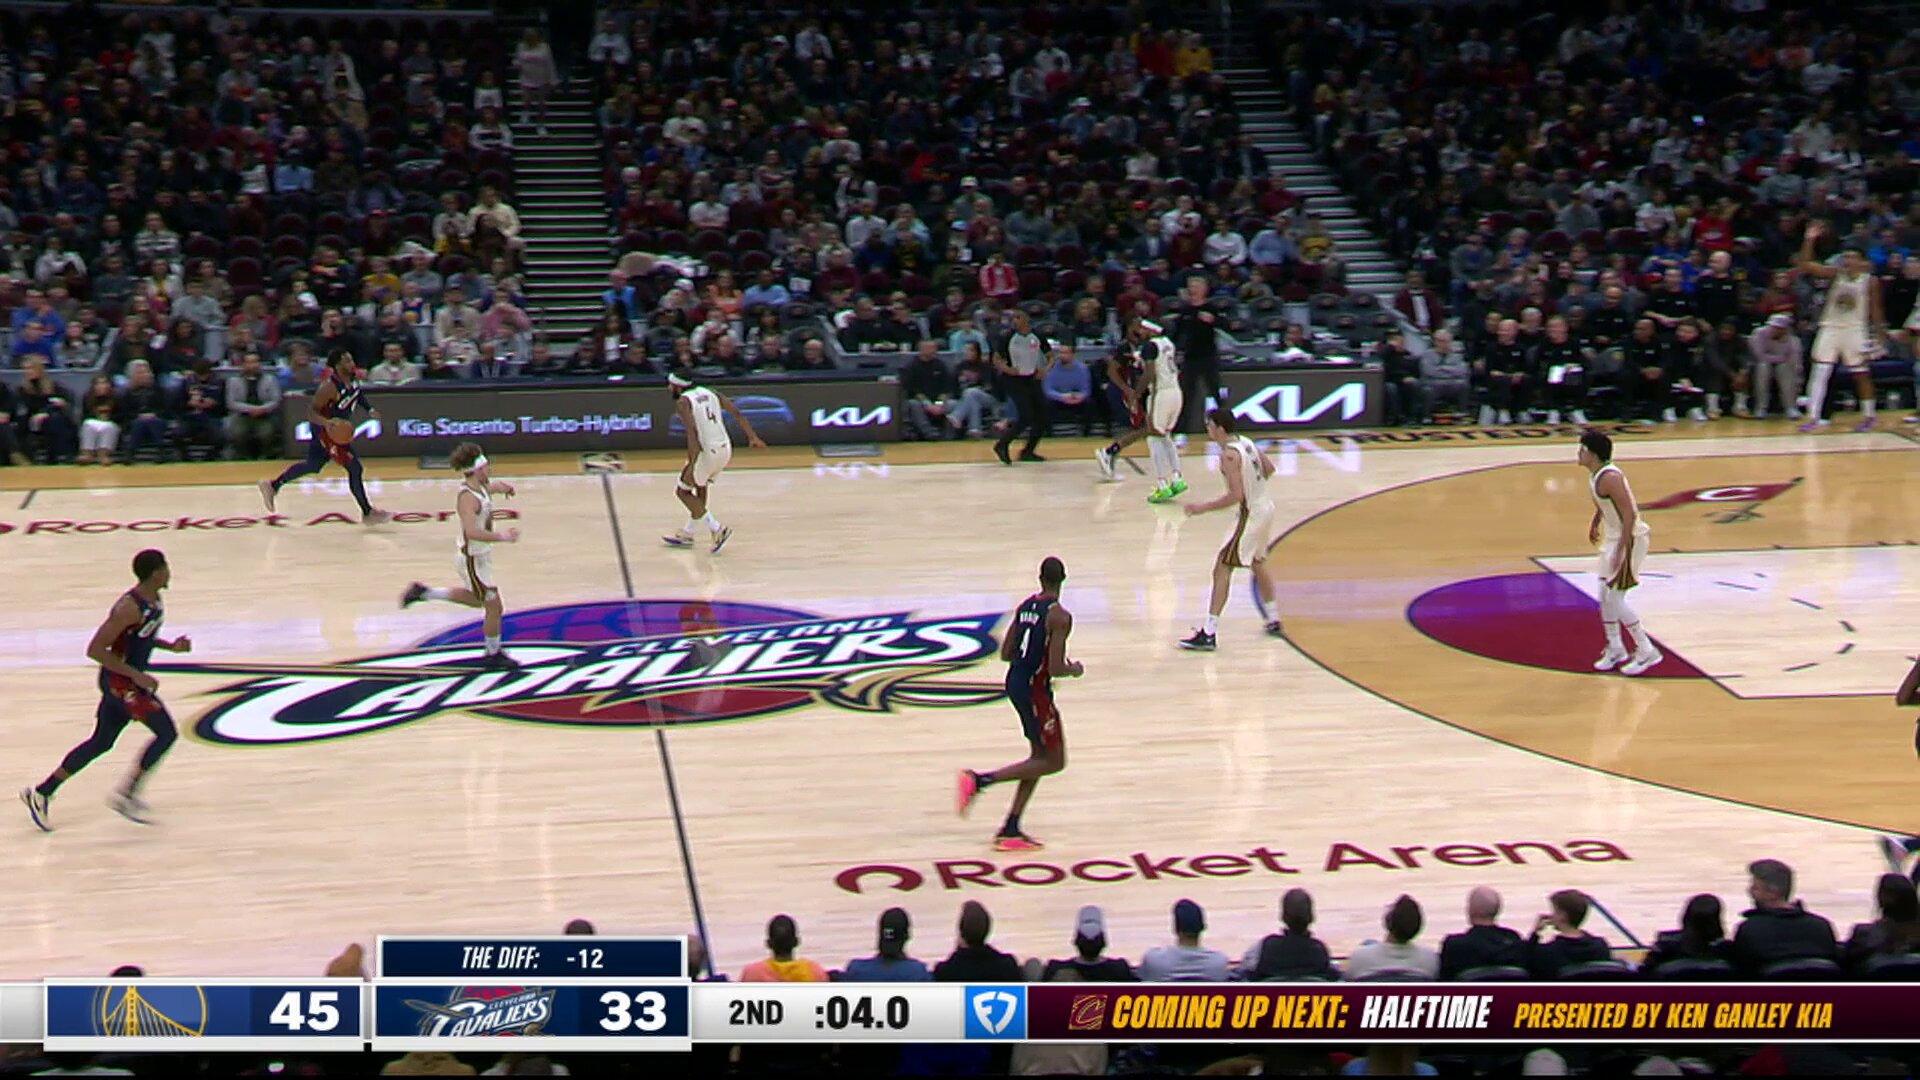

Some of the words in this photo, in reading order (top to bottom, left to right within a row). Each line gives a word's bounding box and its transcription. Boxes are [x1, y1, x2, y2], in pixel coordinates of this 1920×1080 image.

[705, 406, 717, 424] 4
[811, 405, 892, 427] KIA
[1205, 383, 1366, 423] KIA
[398, 418, 433, 436] Kia
[518, 412, 652, 435] Turbo-Hybrid
[25, 513, 291, 535] Rocket
[601, 616, 892, 657] CLEVELAND
[212, 619, 984, 741] CAVALIERS
[934, 850, 1298, 889] Rocket
[1325, 839, 1633, 873] Arena
